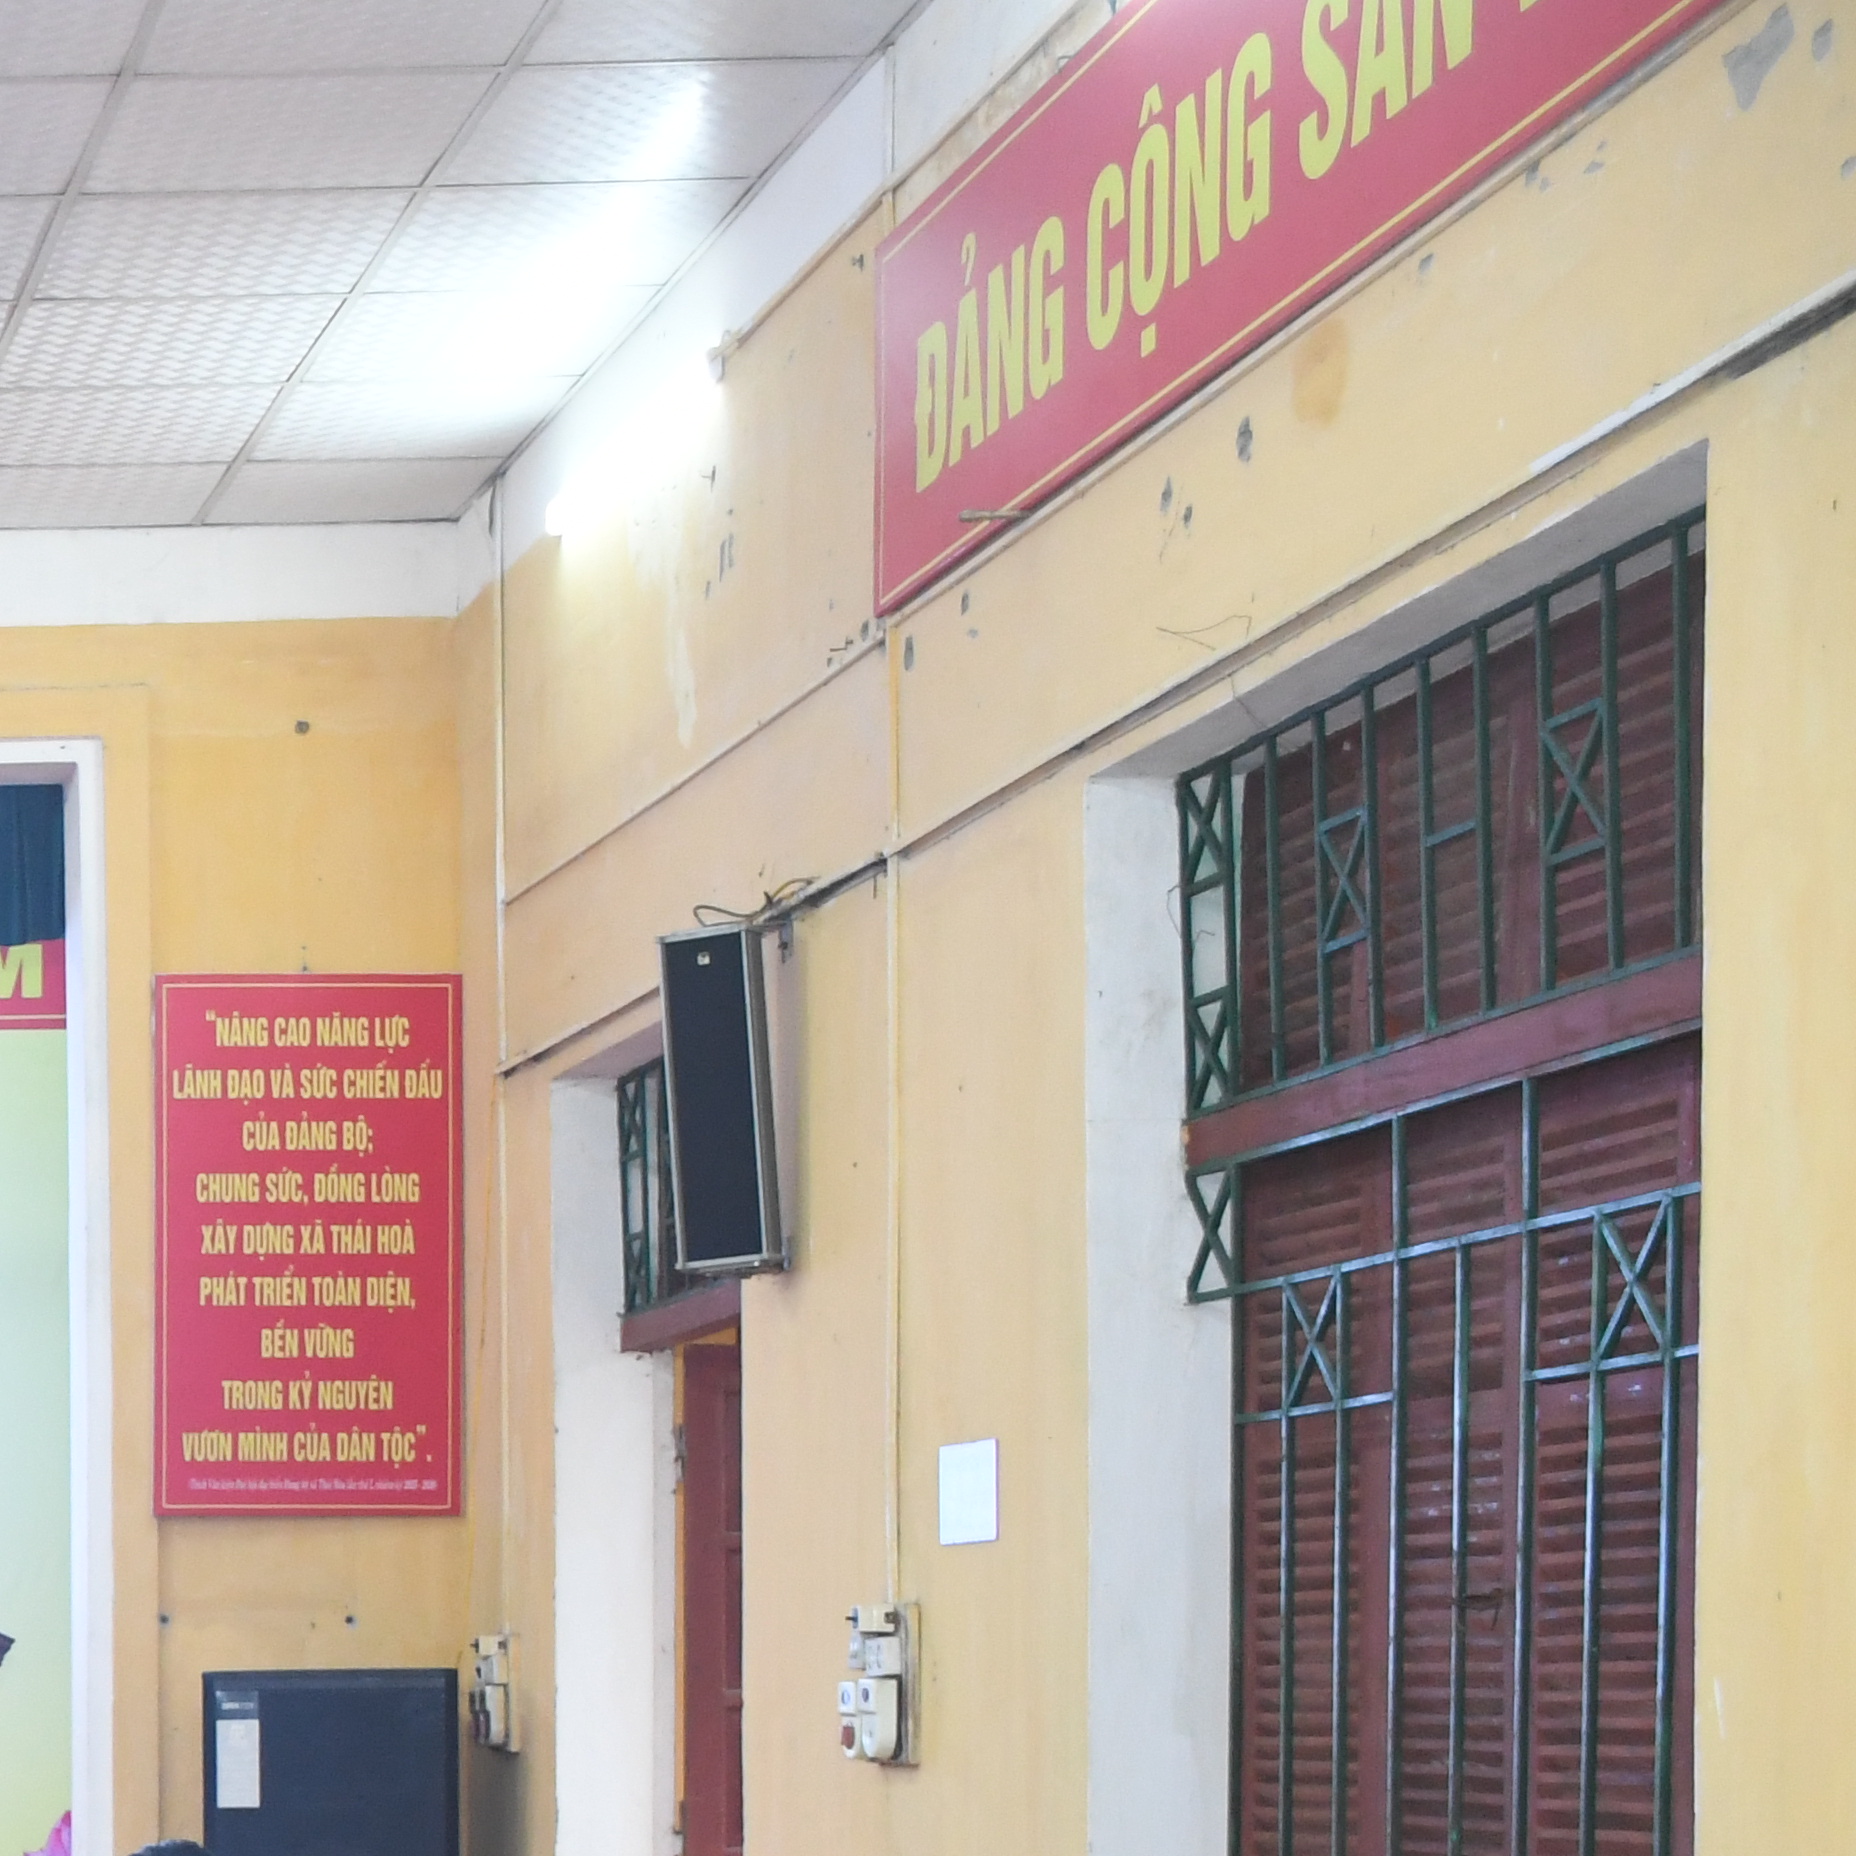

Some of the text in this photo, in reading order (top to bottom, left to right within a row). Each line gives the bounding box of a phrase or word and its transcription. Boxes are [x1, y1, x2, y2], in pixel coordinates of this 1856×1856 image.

[915, 216, 1064, 493] ĐẢNG
[1087, 32, 1272, 358] CỘNG
[274, 1017, 311, 1046] CAO
[317, 1012, 369, 1046] NĂNG
[375, 1015, 409, 1053] LỰC
[173, 1061, 442, 1105] LÃNH ĐẠO VÀ SỨC CHIẾN ĐẤU
[243, 1112, 280, 1151] CỦA
[285, 1112, 337, 1150] ĐẢNG
[196, 1173, 259, 1203] CHUNG
[314, 1164, 365, 1202] ĐỒNG
[372, 1168, 419, 1202] LÒNG
[201, 1219, 237, 1254] XÂY
[243, 1223, 294, 1260] DỰNG
[300, 1220, 325, 1254] XÃ
[331, 1220, 371, 1253] THÁI
[200, 1271, 247, 1306] PHÁT
[253, 1265, 306, 1306] TRIỂN
[312, 1272, 360, 1306] TOÀN
[261, 1320, 353, 1358] BỀN VỮNG
[222, 1372, 392, 1409] TRONG KỶ NGUYÊN
[182, 1430, 232, 1461] VƯƠN
[238, 1427, 287, 1461] MÌNH
[294, 1423, 330, 1461] CỦA
[337, 1427, 375, 1461] DÂN
